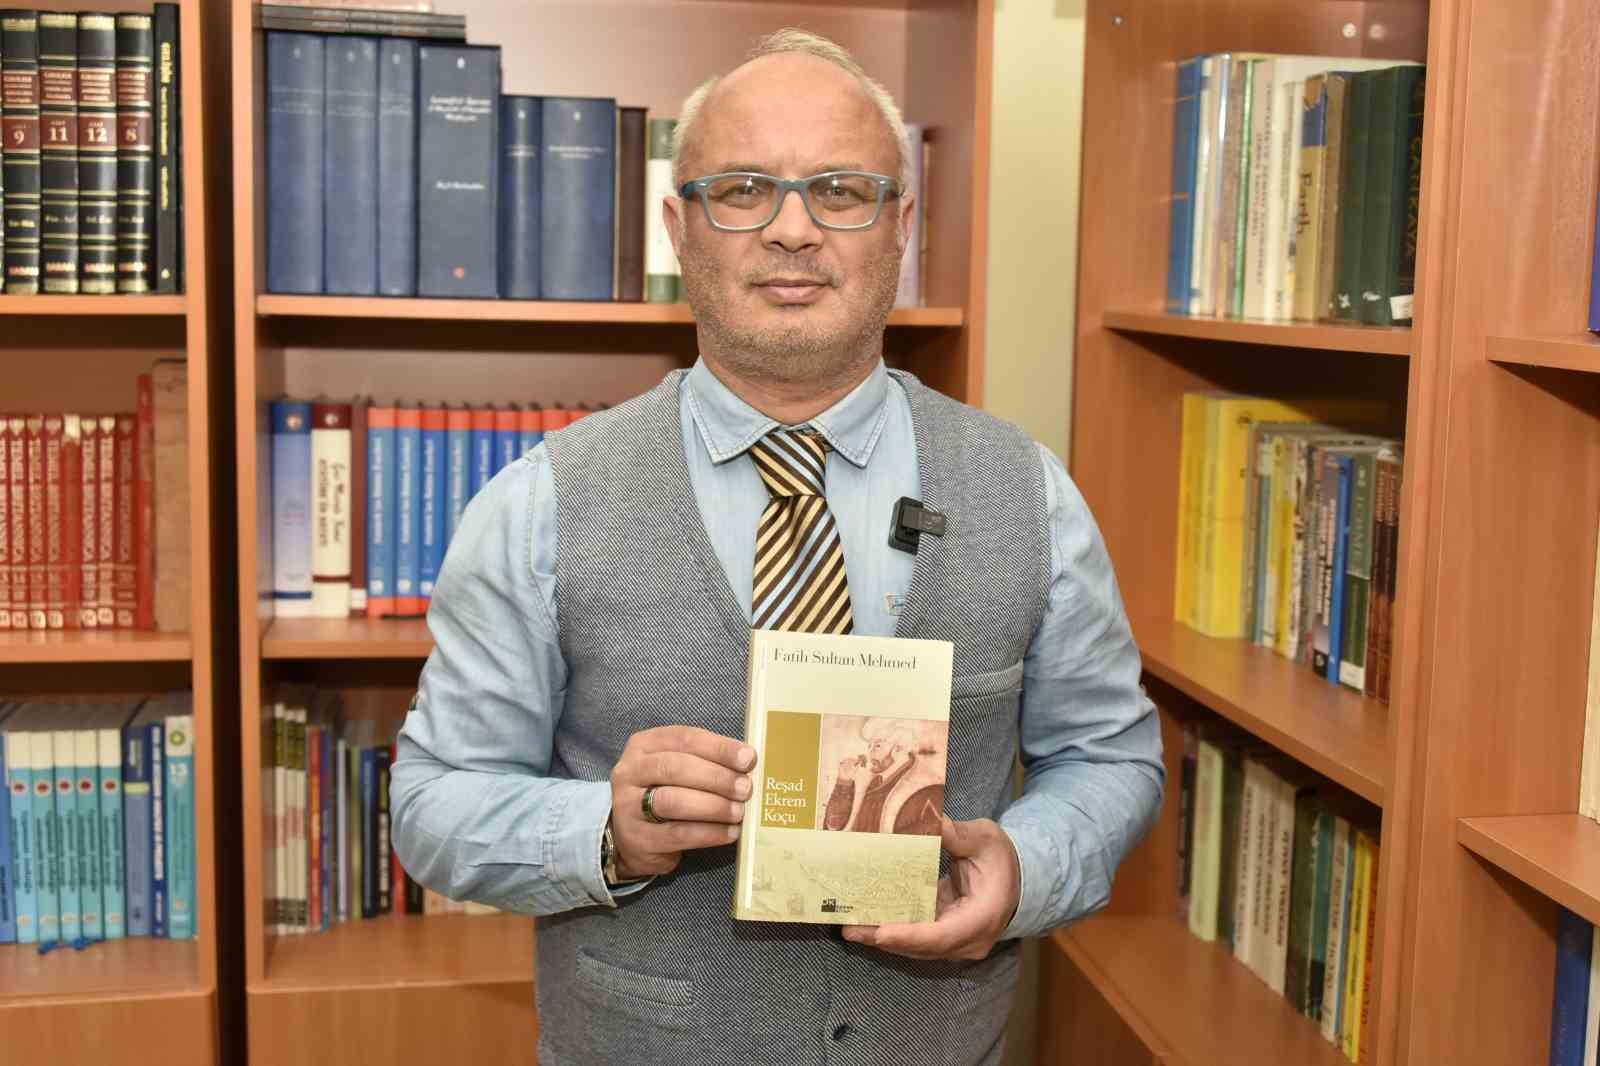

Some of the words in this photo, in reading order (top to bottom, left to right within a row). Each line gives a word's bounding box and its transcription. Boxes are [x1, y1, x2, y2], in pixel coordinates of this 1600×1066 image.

[12, 129, 25, 144] 9
[49, 127, 68, 141] 11
[87, 127, 108, 142] 12
[125, 128, 137, 142] 8
[774, 647, 808, 663] Fatih
[812, 650, 855, 666] Sultan
[859, 652, 916, 669] Mehmed
[767, 777, 803, 793] Reşad
[765, 792, 807, 807] Ekrem
[764, 808, 796, 825] Koçu
